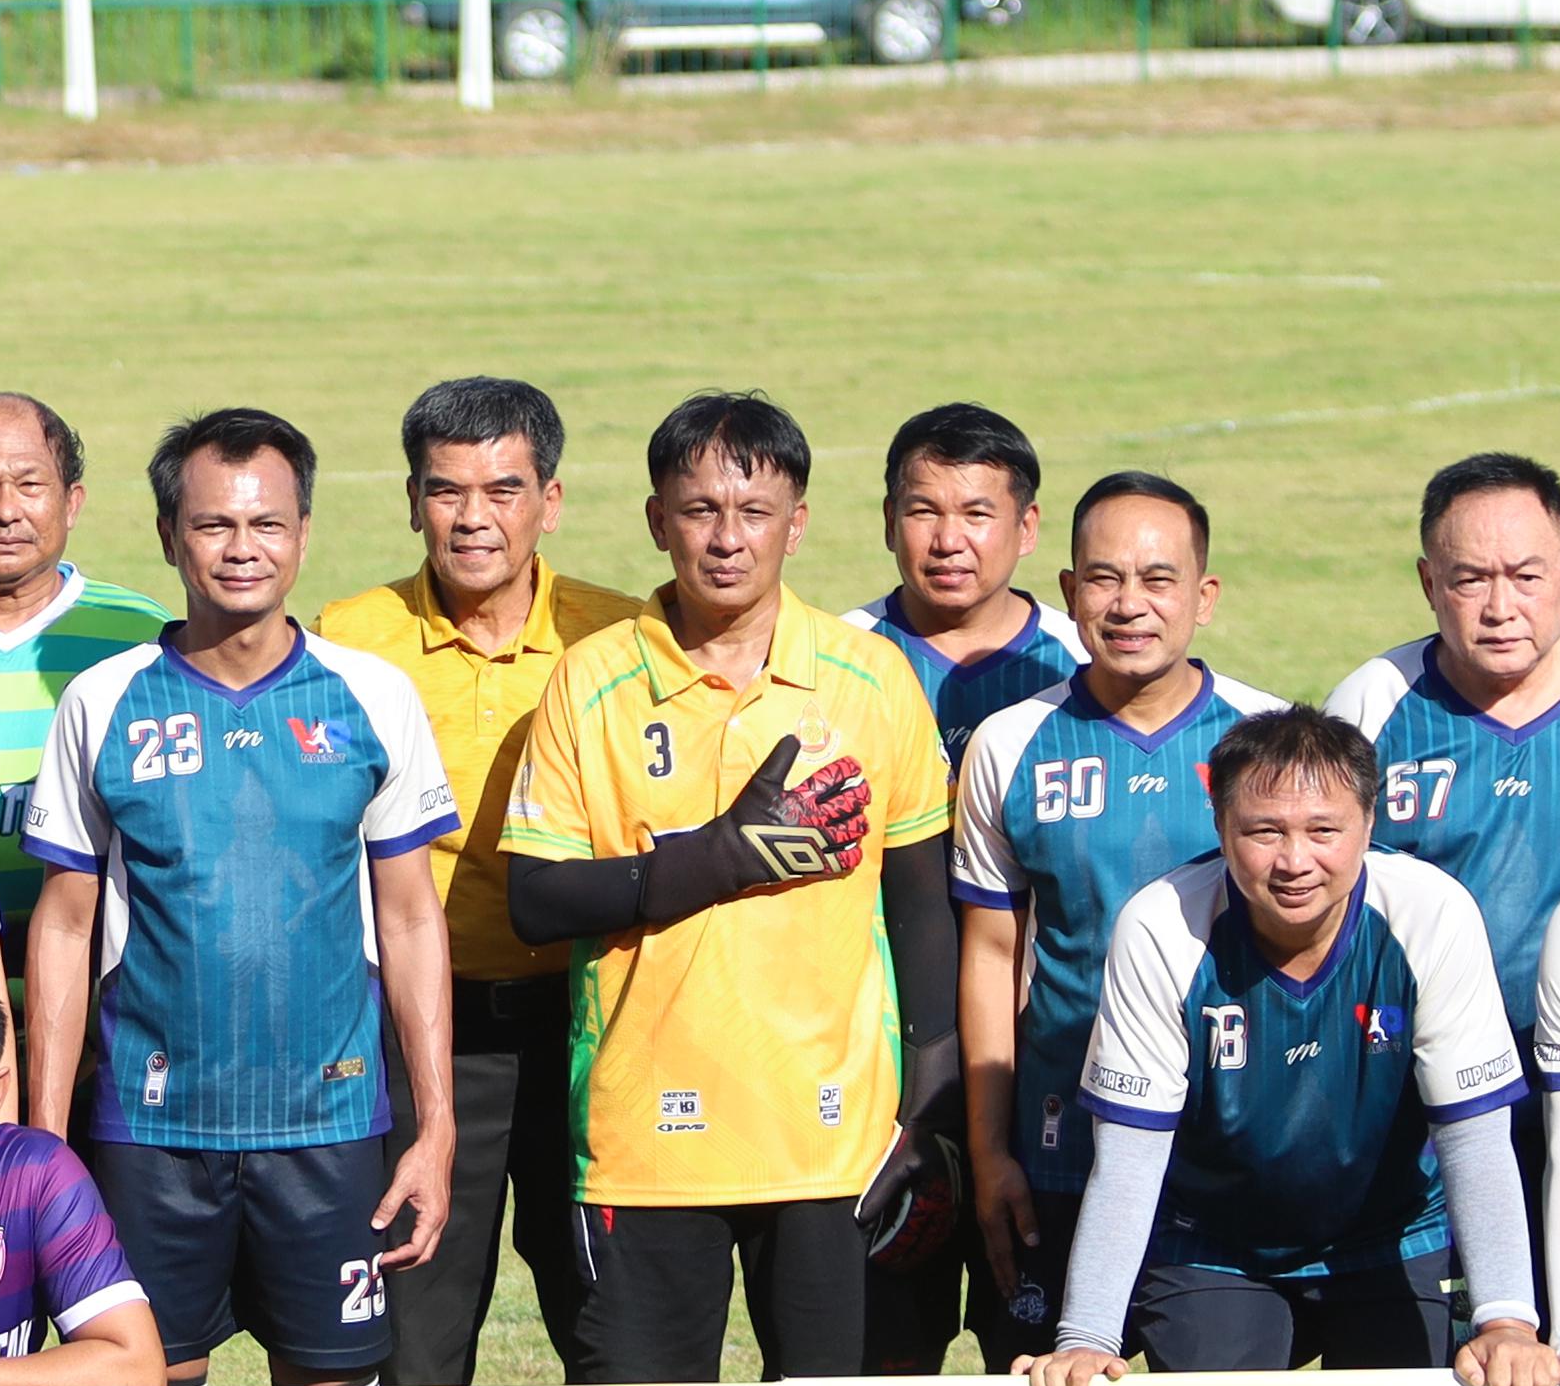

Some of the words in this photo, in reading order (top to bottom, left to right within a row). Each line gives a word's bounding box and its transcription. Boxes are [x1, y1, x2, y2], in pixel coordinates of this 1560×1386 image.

[126, 711, 204, 784] 23
[644, 721, 673, 778] 3
[1034, 756, 1107, 825] 50
